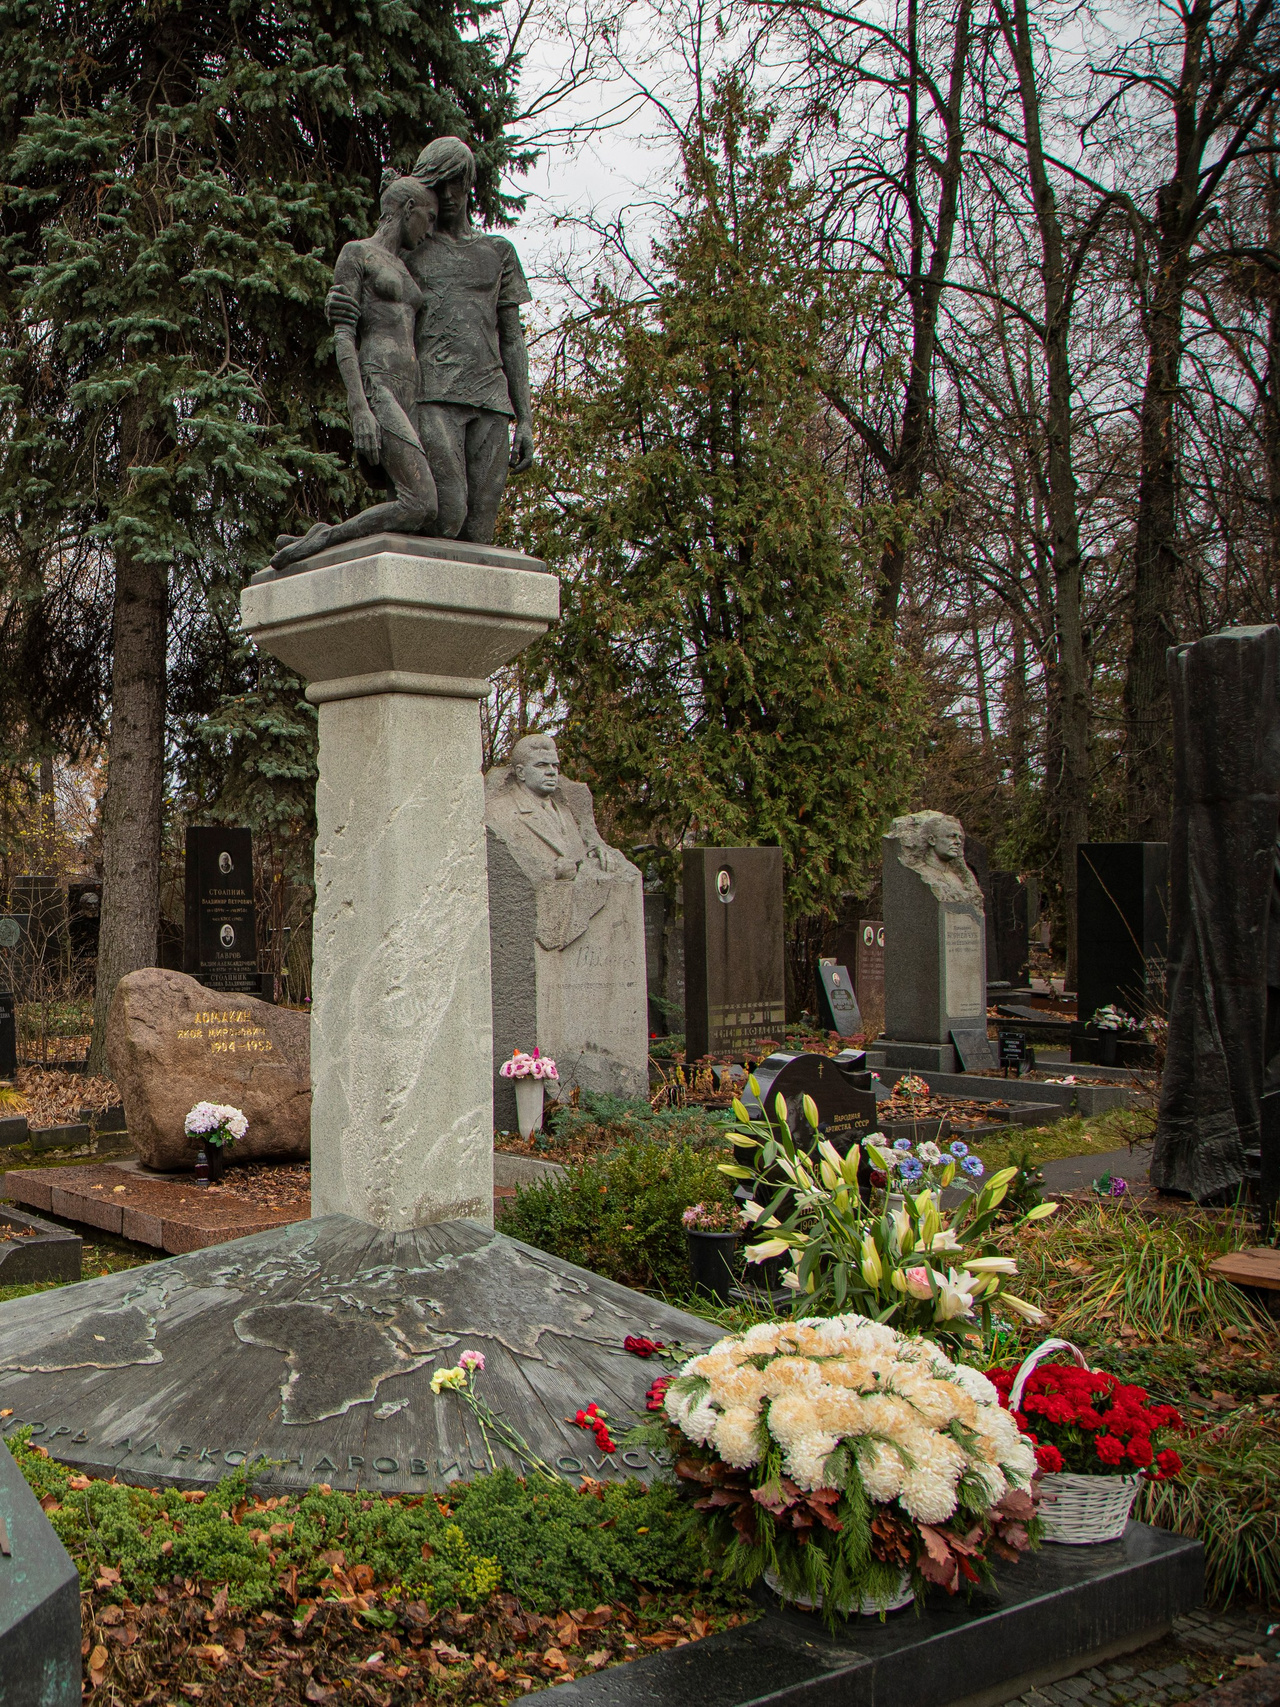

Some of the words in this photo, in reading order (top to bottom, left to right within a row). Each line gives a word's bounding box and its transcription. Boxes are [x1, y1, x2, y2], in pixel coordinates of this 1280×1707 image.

[193, 1010, 252, 1024] ЛОМАКИН
[825, 1123, 852, 1133] АРТИСТКА
[854, 1119, 870, 1128] СССР
[111, 1437, 493, 1475] АЛЕКСАНДРОВИЧ
[519, 1449, 673, 1475] ОИСЕ
